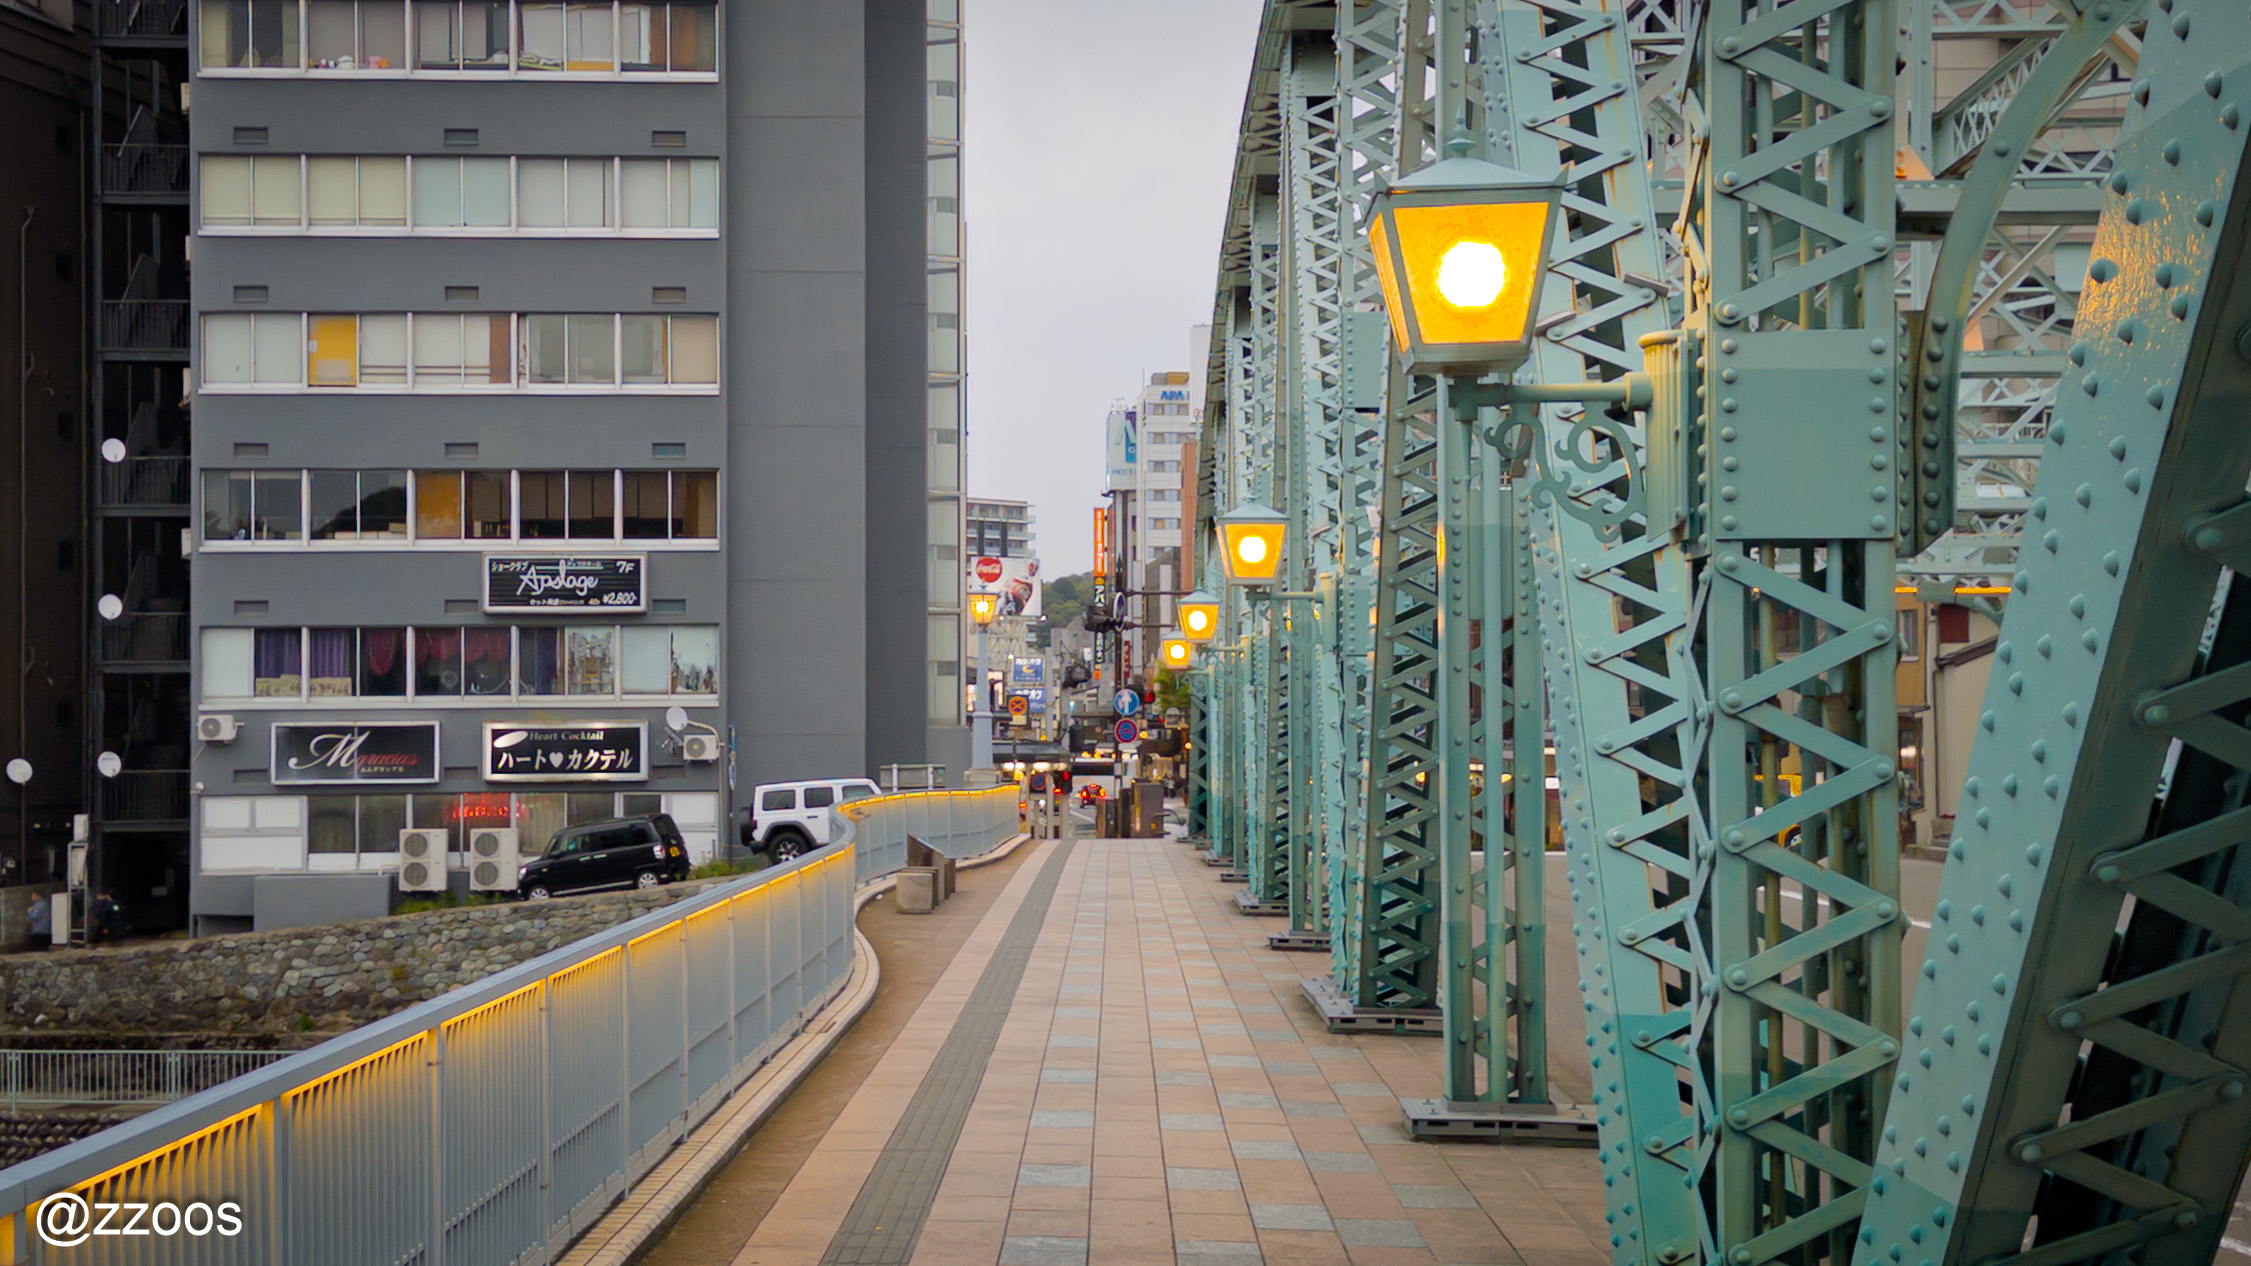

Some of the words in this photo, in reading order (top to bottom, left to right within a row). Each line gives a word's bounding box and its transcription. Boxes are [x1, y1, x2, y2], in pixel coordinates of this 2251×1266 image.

[1160, 390, 1184, 400] APA
[616, 560, 635, 573] 7F
[529, 731, 557, 741] Heart
[561, 730, 604, 741] Cocktail
